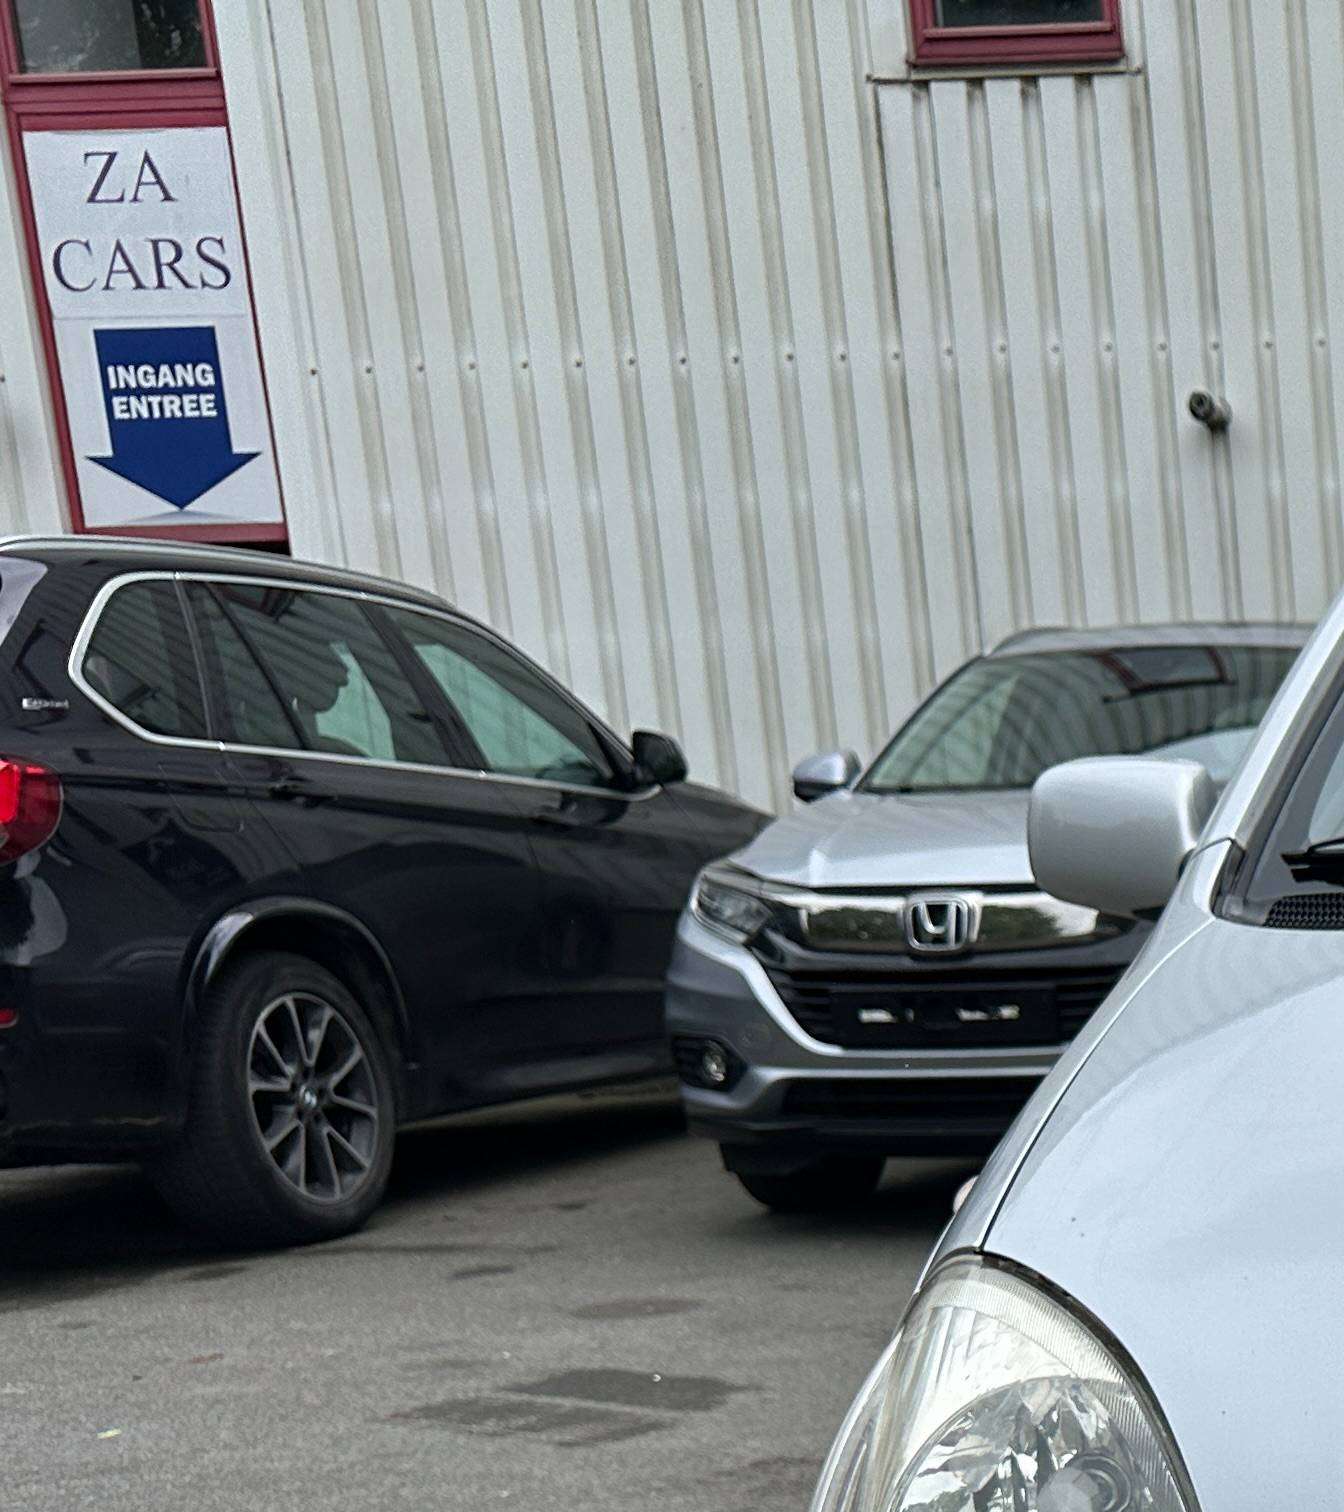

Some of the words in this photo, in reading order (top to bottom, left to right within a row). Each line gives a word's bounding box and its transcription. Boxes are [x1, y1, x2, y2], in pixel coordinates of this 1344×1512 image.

[83, 150, 177, 203] ZA
[53, 235, 232, 292] CARS
[107, 362, 215, 390] INGANG
[112, 393, 218, 421] ENTREE
